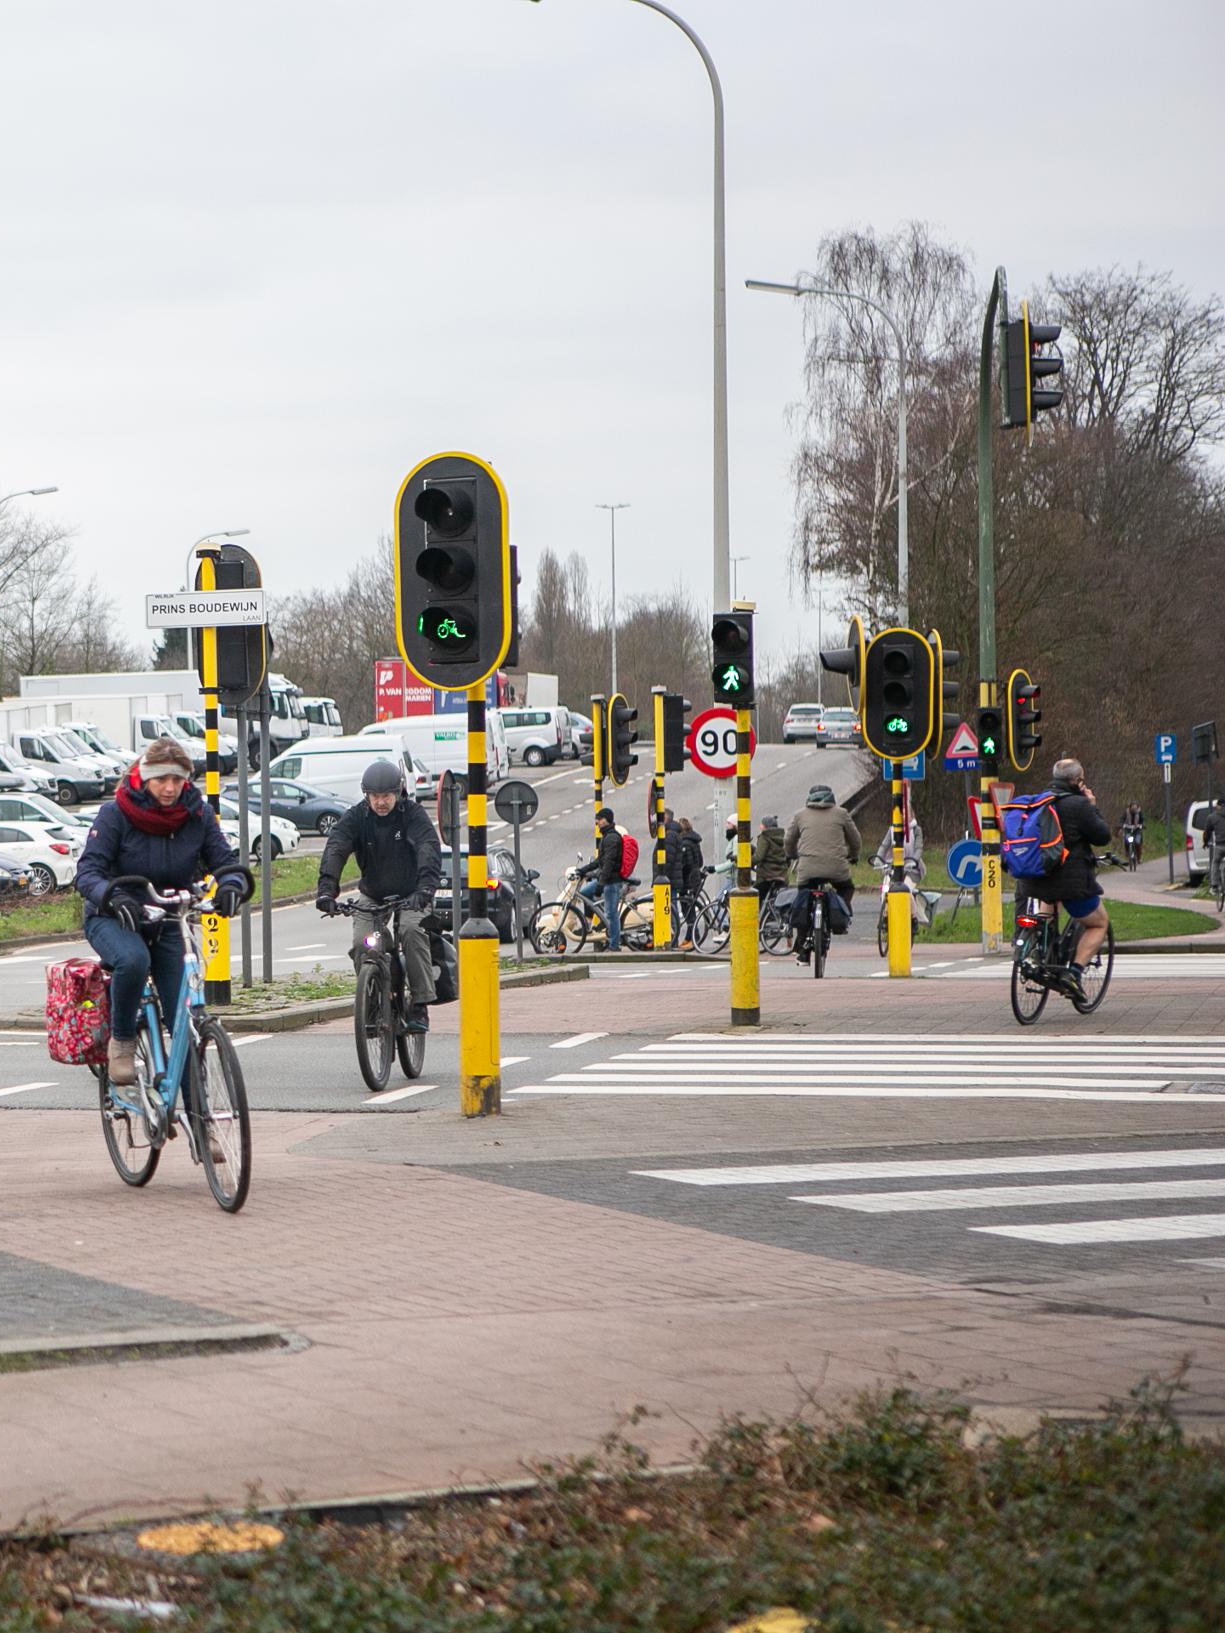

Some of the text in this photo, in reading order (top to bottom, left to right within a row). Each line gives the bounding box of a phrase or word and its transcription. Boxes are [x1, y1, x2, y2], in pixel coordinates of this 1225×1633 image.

[151, 602, 258, 615] PRINS BOUDEWIJN
[386, 687, 402, 696] VAN
[701, 729, 738, 757] 90
[1160, 736, 1172, 753] P
